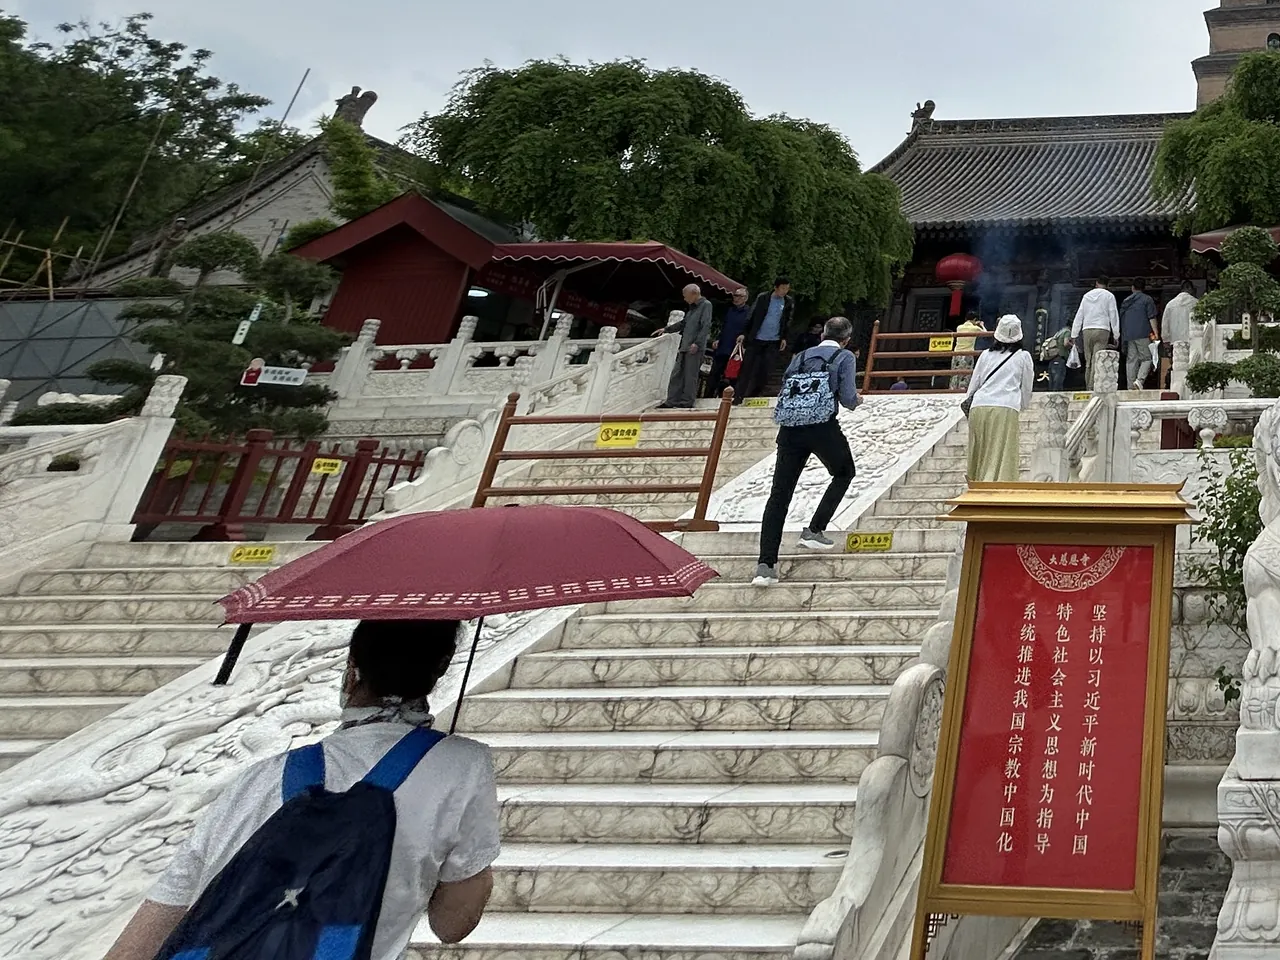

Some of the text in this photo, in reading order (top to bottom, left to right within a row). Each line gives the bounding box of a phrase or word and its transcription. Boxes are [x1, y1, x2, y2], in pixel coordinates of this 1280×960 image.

[1049, 552, 1091, 566] 大慈恩寺
[996, 601, 1037, 853] 系统推进我国宗教中国化
[1034, 602, 1073, 855] 特色社会主义思想为指导
[1072, 603, 1107, 856] 坚持以习近平新时代中国
